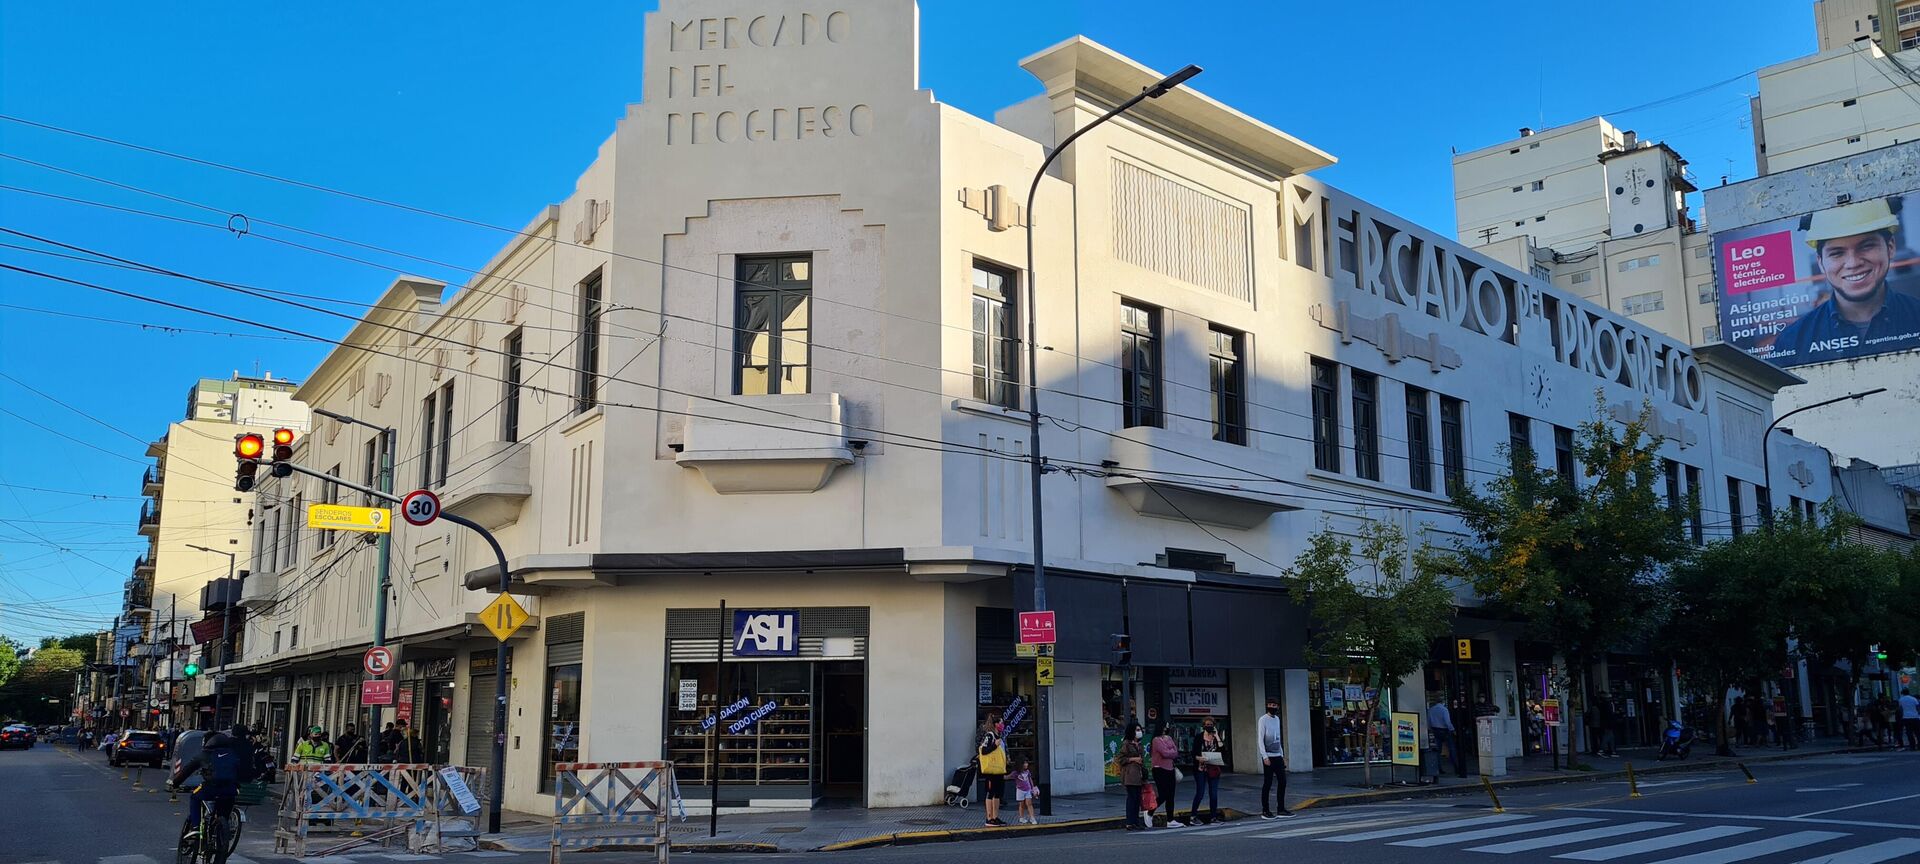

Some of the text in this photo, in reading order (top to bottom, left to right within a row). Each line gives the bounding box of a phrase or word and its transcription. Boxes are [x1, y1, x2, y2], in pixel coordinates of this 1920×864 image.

[669, 9, 850, 52] MERCADO
[668, 63, 736, 98] DEL
[666, 103, 874, 146] PROGRESO
[1731, 245, 1765, 262] Leo
[1732, 263, 1749, 273] hoy
[1733, 268, 1767, 280] técnico
[1734, 272, 1785, 288] electrónico
[1284, 180, 1706, 413] MERCADO DEL PROGRESO
[1729, 293, 1810, 316] Asignación
[1730, 305, 1798, 328] universal
[1732, 328, 1757, 341] por
[1809, 335, 1860, 353] ANSES
[1865, 332, 1920, 344] argentina.gob.ar
[410, 500, 432, 516] 30
[736, 614, 794, 651] ASH
[373, 652, 385, 669] E
[702, 697, 750, 729] LIQDACION
[729, 701, 777, 733] TODO CUERO
